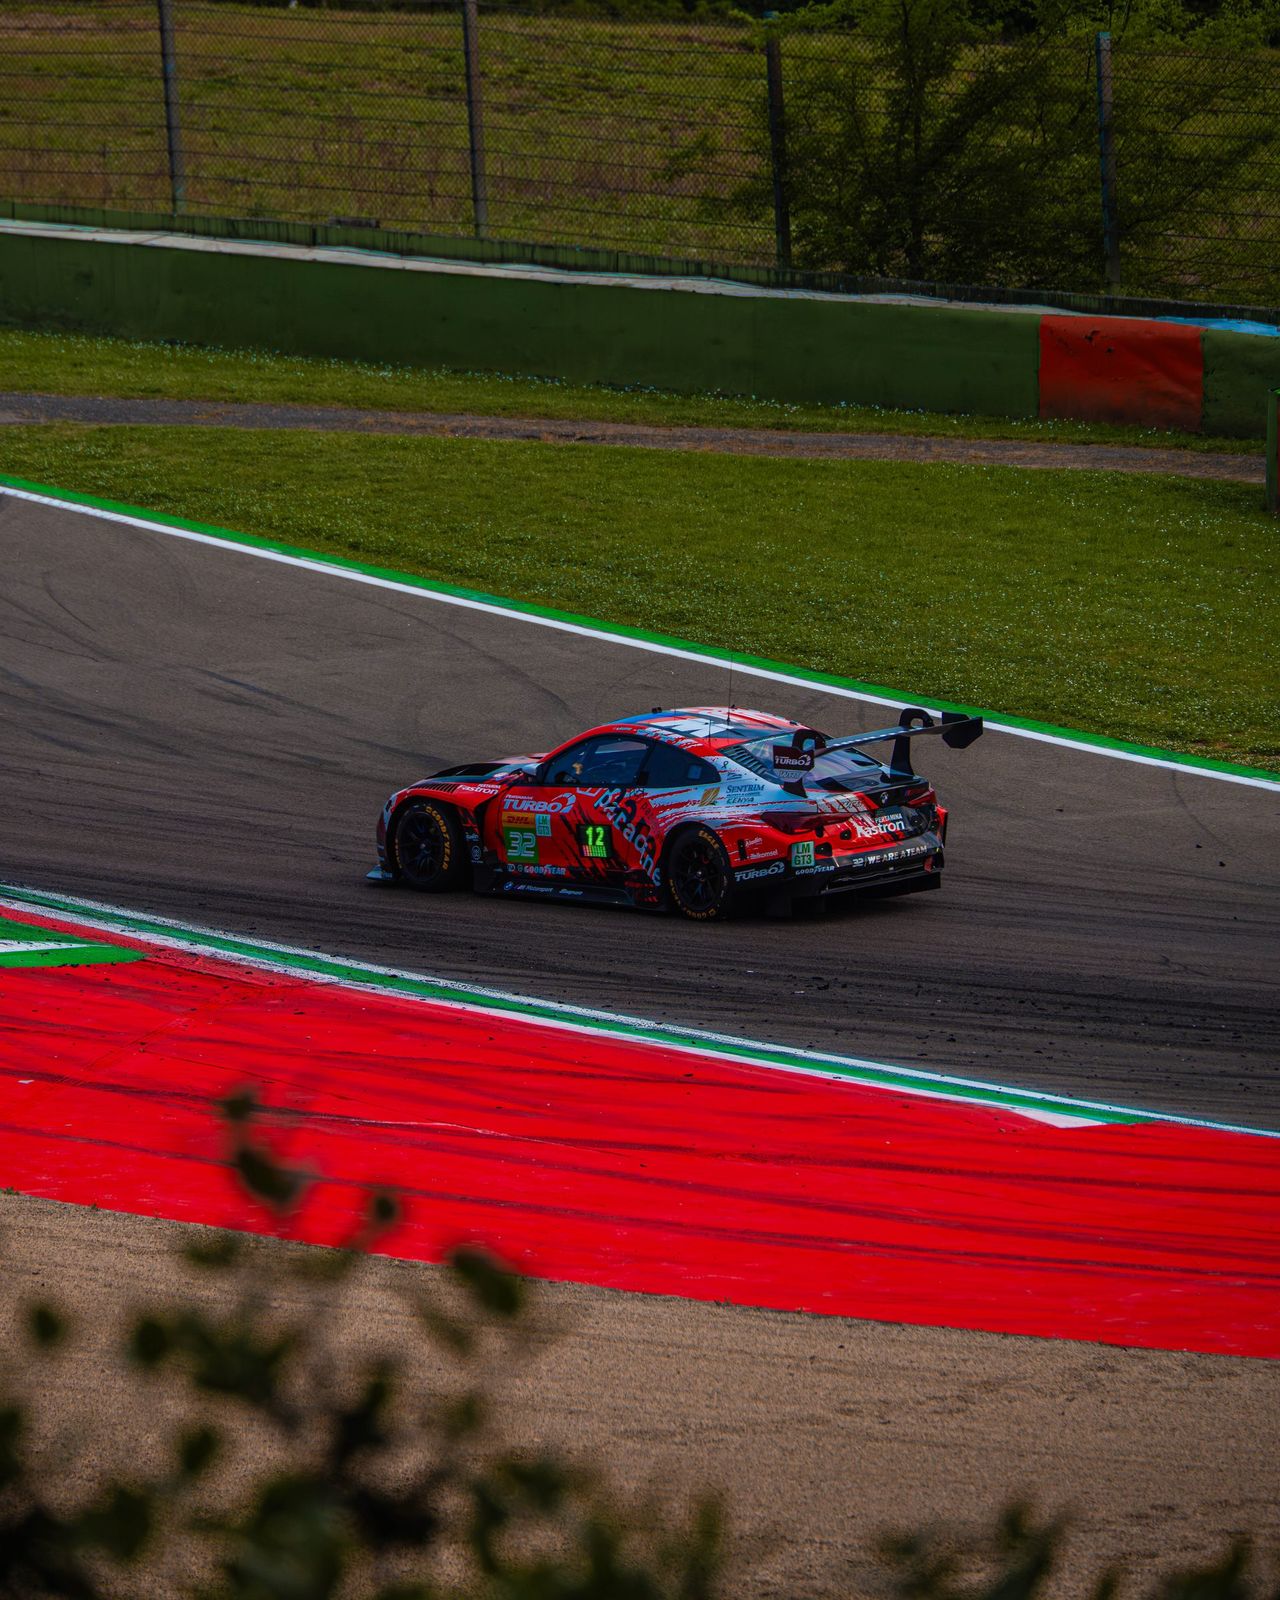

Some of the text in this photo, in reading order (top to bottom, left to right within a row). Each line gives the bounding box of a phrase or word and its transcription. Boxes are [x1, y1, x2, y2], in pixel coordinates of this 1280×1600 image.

[457, 784, 499, 795] Fastron
[503, 798, 563, 813] TURBO
[506, 815, 530, 825] DHL
[585, 826, 605, 846] 12
[507, 832, 537, 857] 32
[796, 843, 811, 854] LM
[794, 855, 812, 865] GT3
[867, 855, 881, 865] WE
[882, 851, 899, 862] ARE
[906, 845, 928, 857] TEAM
[524, 864, 566, 875] GOODYEAR
[795, 864, 835, 875] GOODYEAR
